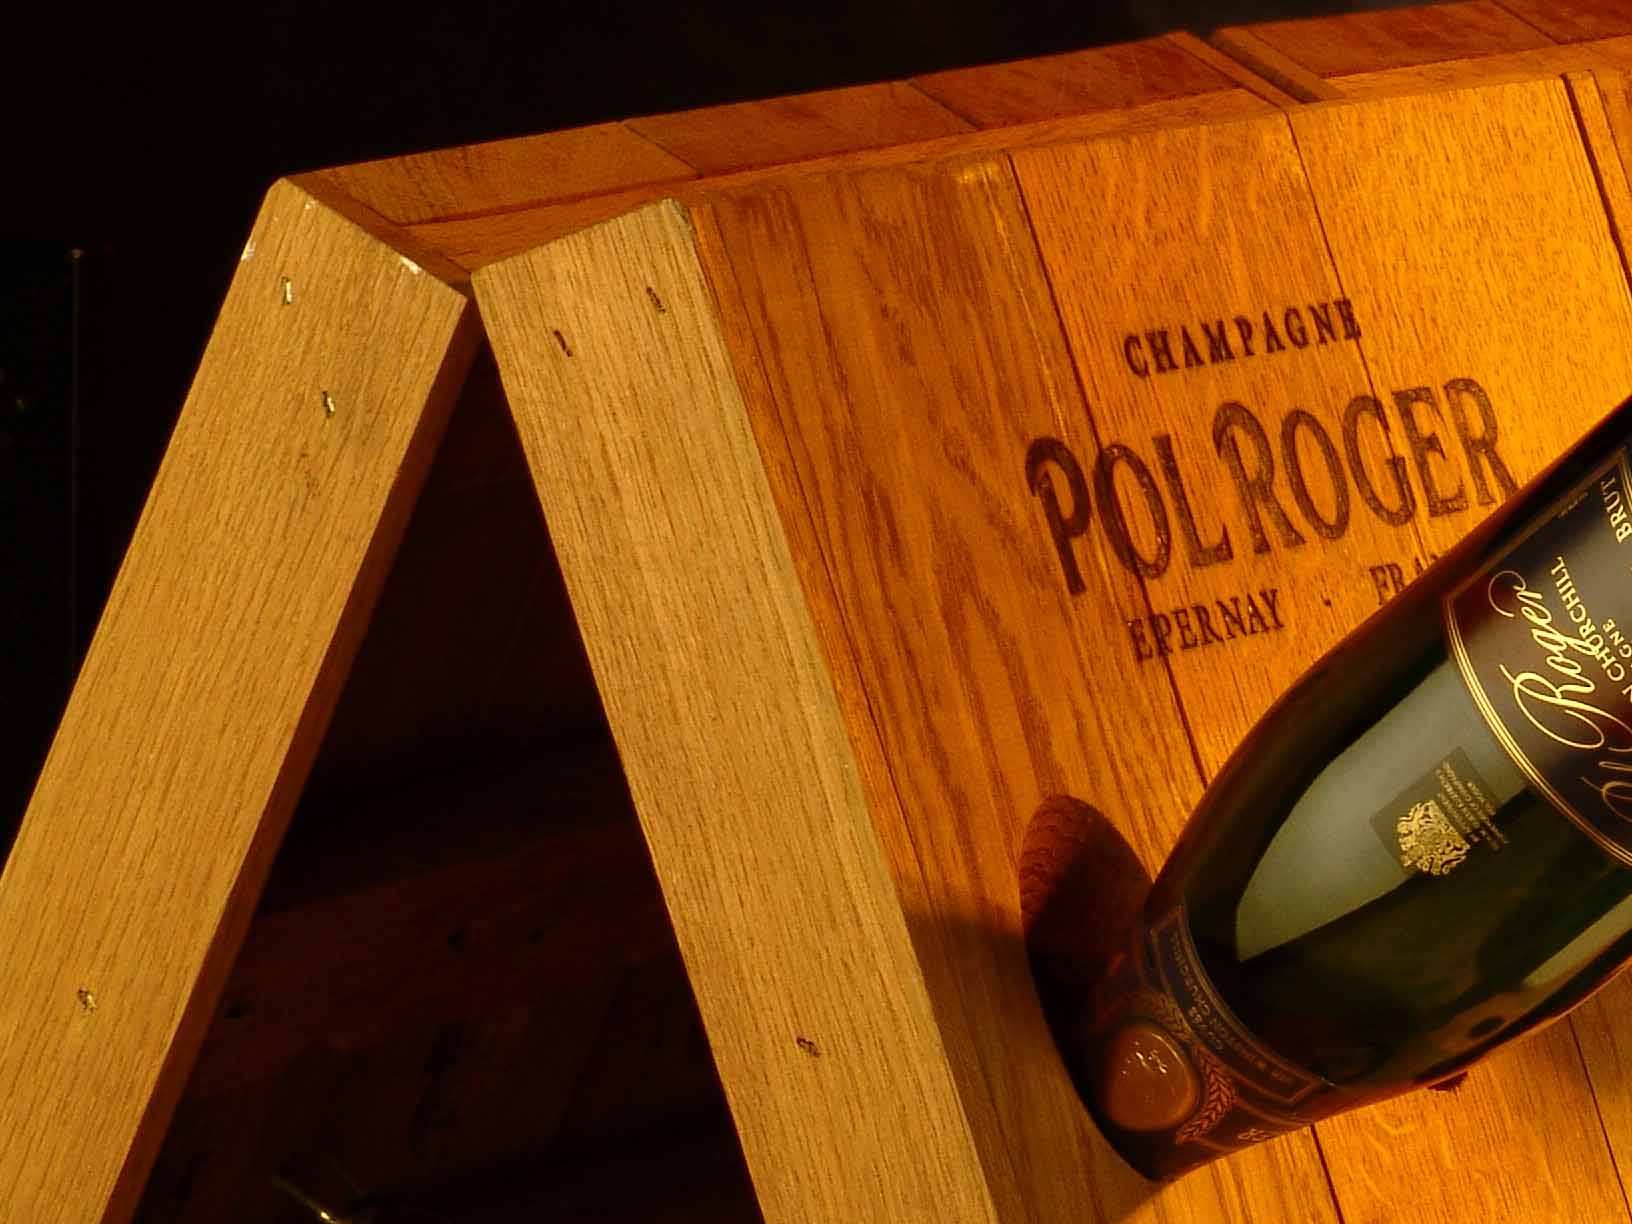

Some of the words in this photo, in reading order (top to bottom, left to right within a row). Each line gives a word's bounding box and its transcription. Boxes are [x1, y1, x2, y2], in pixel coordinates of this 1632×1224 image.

[1124, 297, 1362, 377] CHAMPAGNE
[1025, 436, 1233, 595] POL
[1213, 377, 1521, 554] ROGER
[1598, 474, 1632, 542] BRUT
[1128, 588, 1284, 661] EPERNAY
[1548, 554, 1627, 684] CHURCHILL
